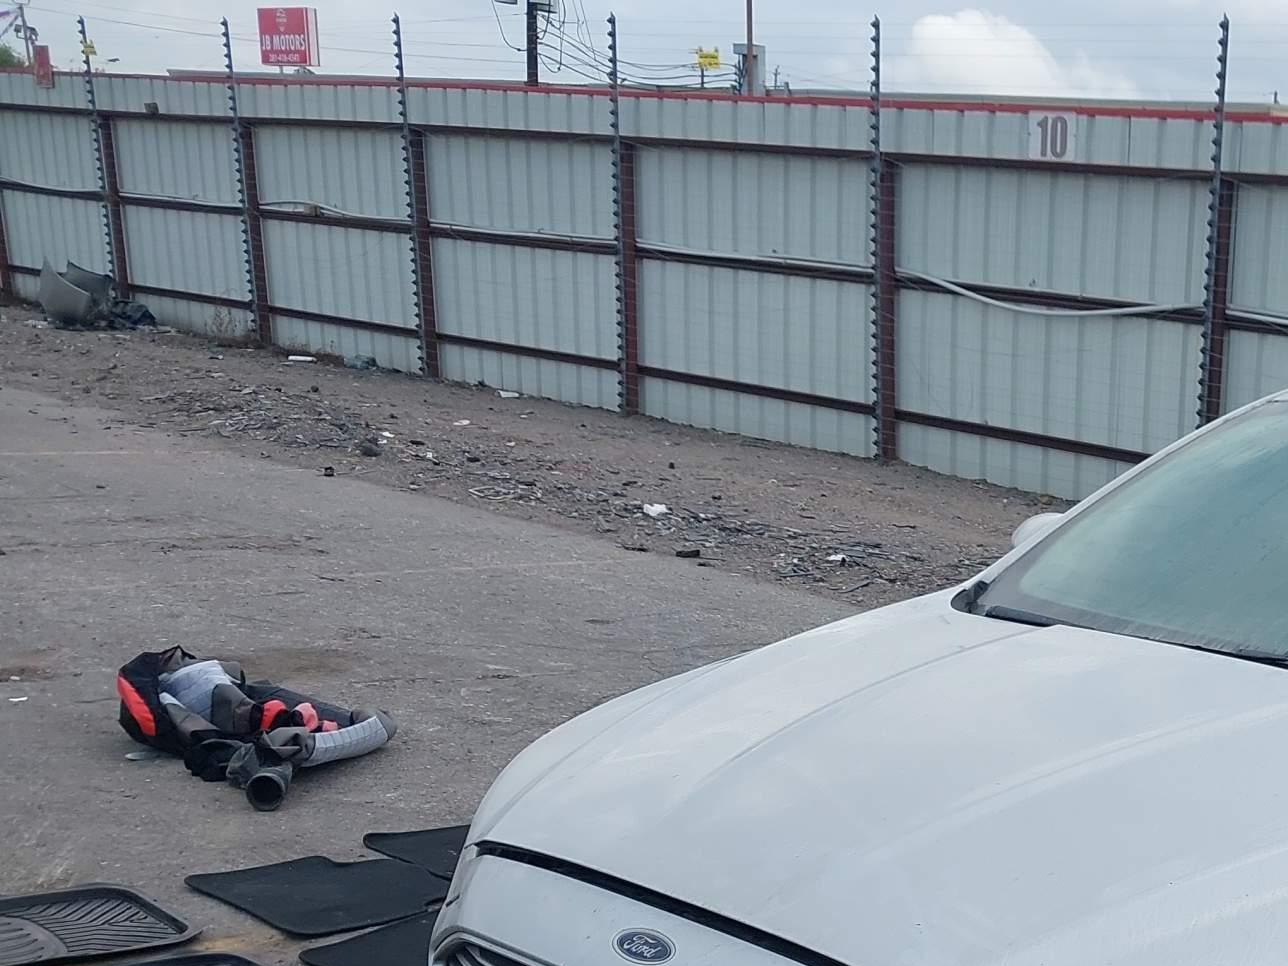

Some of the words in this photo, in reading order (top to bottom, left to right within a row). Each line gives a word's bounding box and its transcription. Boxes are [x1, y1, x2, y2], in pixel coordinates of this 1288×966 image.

[262, 34, 271, 51] JB
[272, 34, 306, 51] MOTORS
[1037, 115, 1068, 158] 10
[623, 934, 662, 958] Ford
